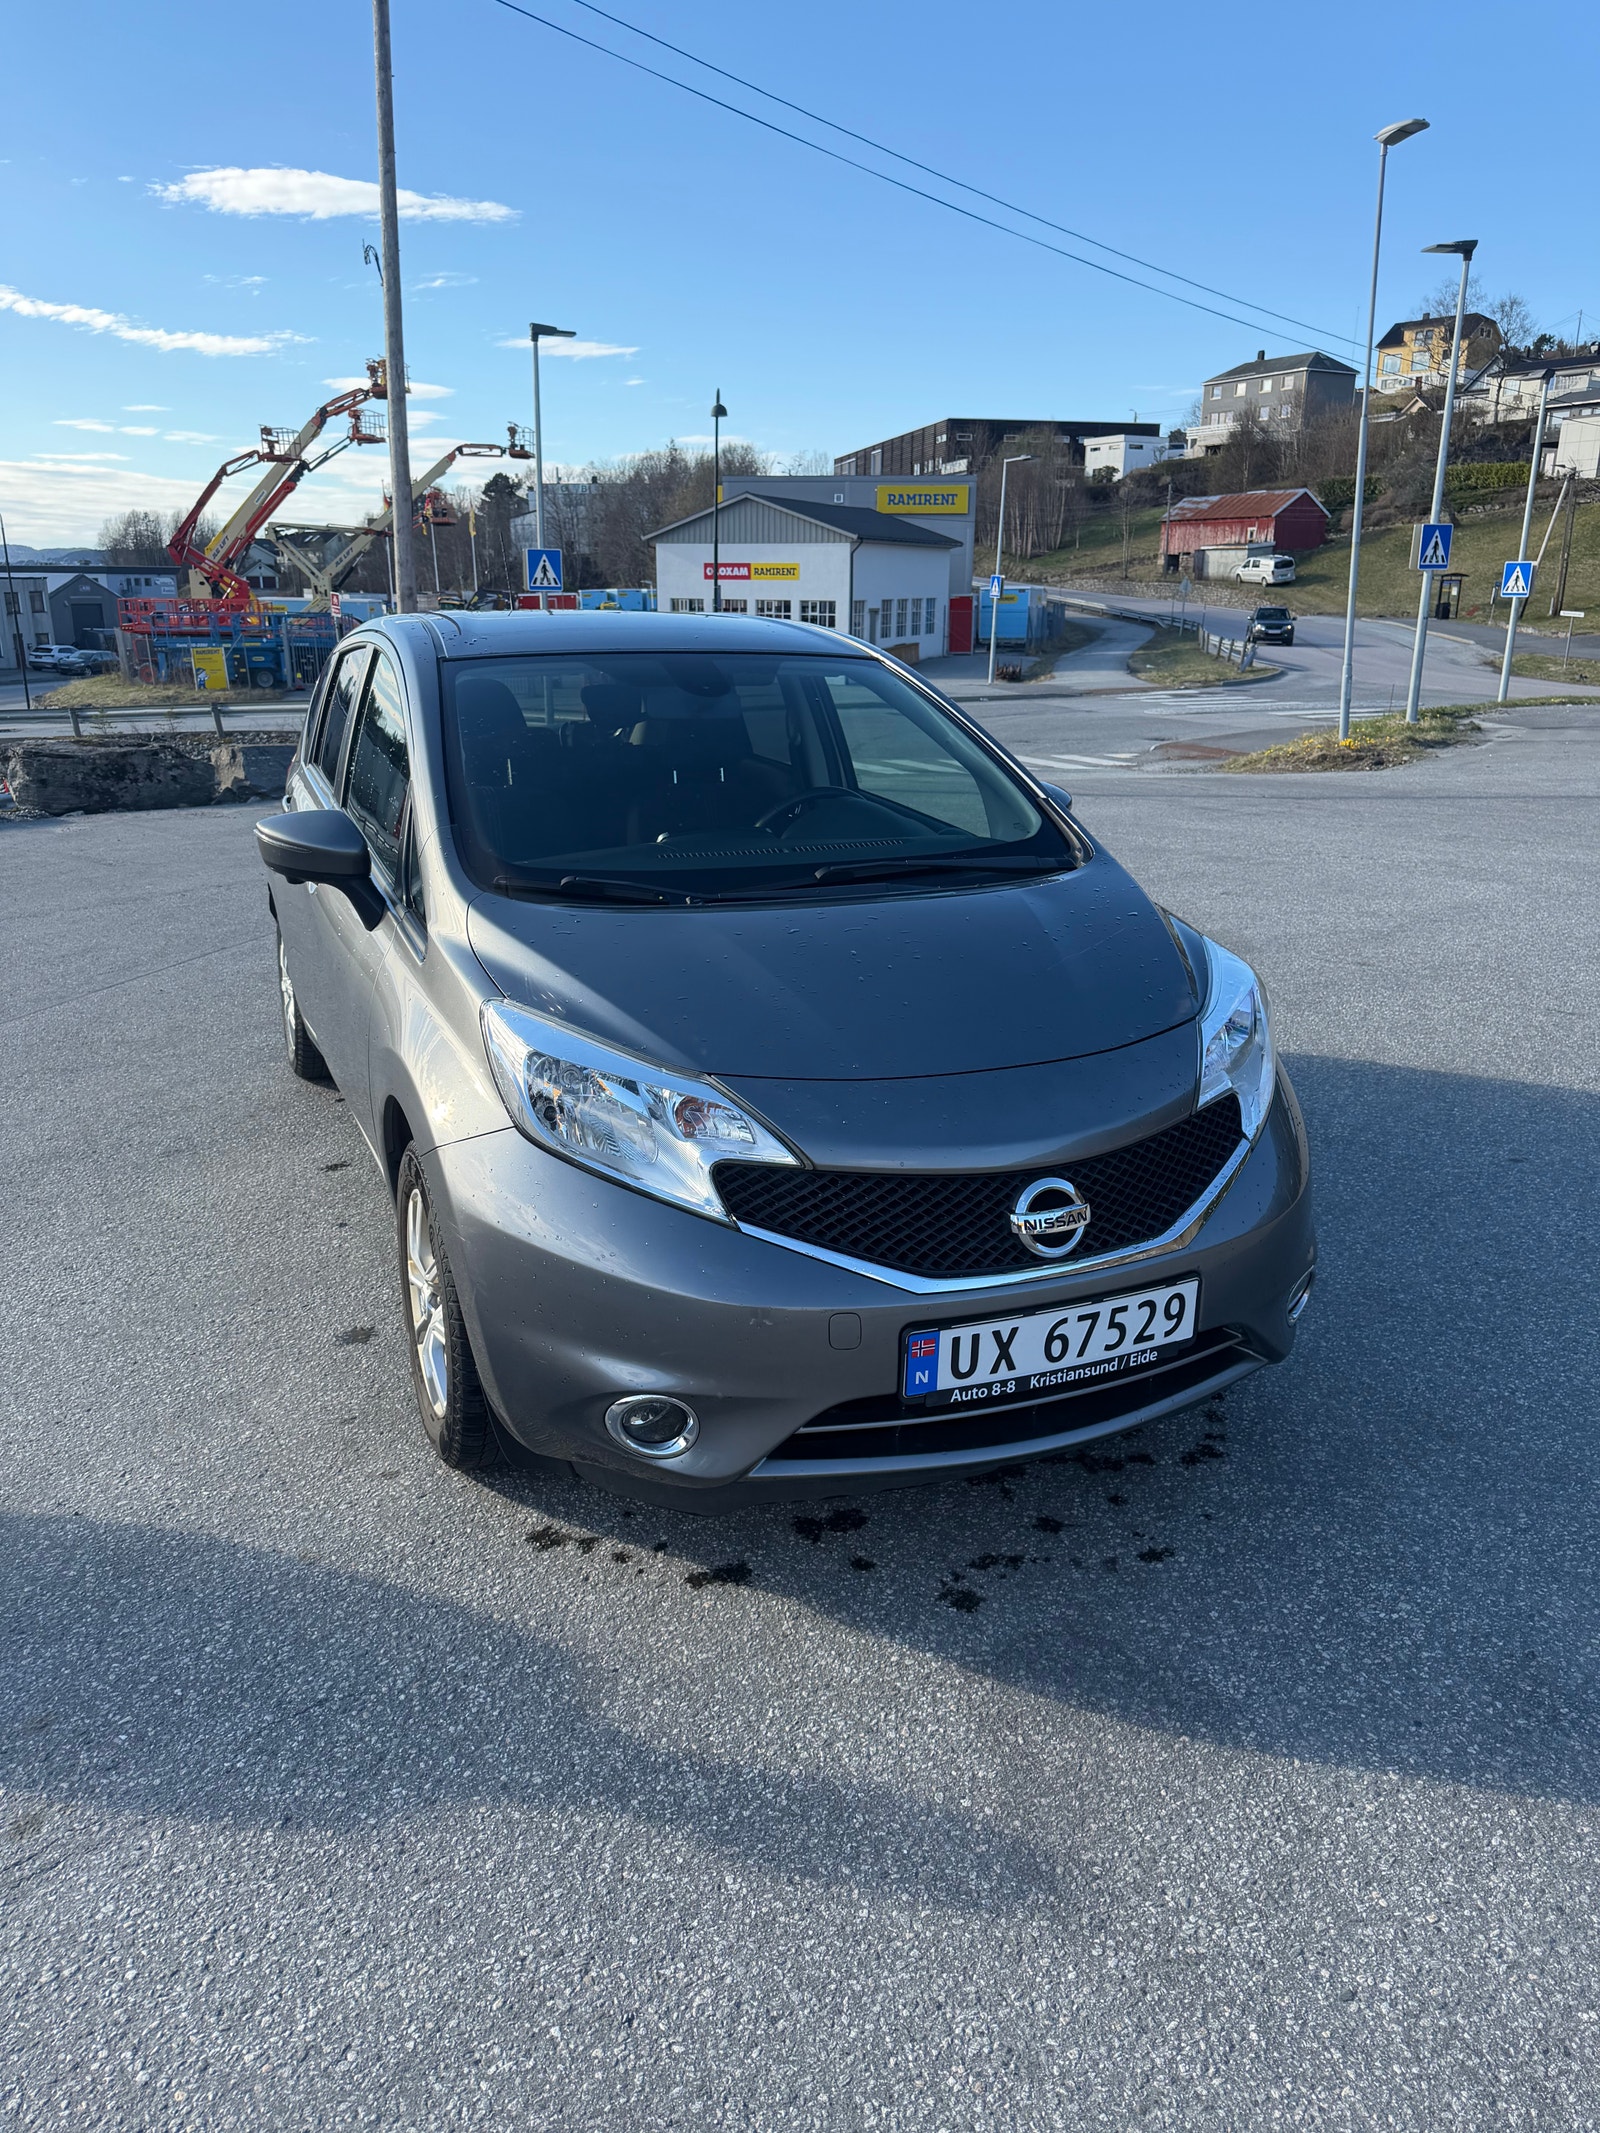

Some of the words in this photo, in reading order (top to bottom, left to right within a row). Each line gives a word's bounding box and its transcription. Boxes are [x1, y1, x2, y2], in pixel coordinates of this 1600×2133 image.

[887, 493, 958, 506] RAMIRENT
[714, 566, 749, 576] OXAM
[753, 567, 797, 576] RAMIRENT
[1024, 1210, 1088, 1231] NISSAN
[950, 1326, 1019, 1380] UX
[1044, 1292, 1187, 1364] 67529
[914, 1370, 929, 1385] N
[950, 1384, 988, 1403] Auto
[991, 1380, 1017, 1395] 8-8
[1030, 1358, 1119, 1390] Kristiansund
[1129, 1349, 1159, 1368] Eide
